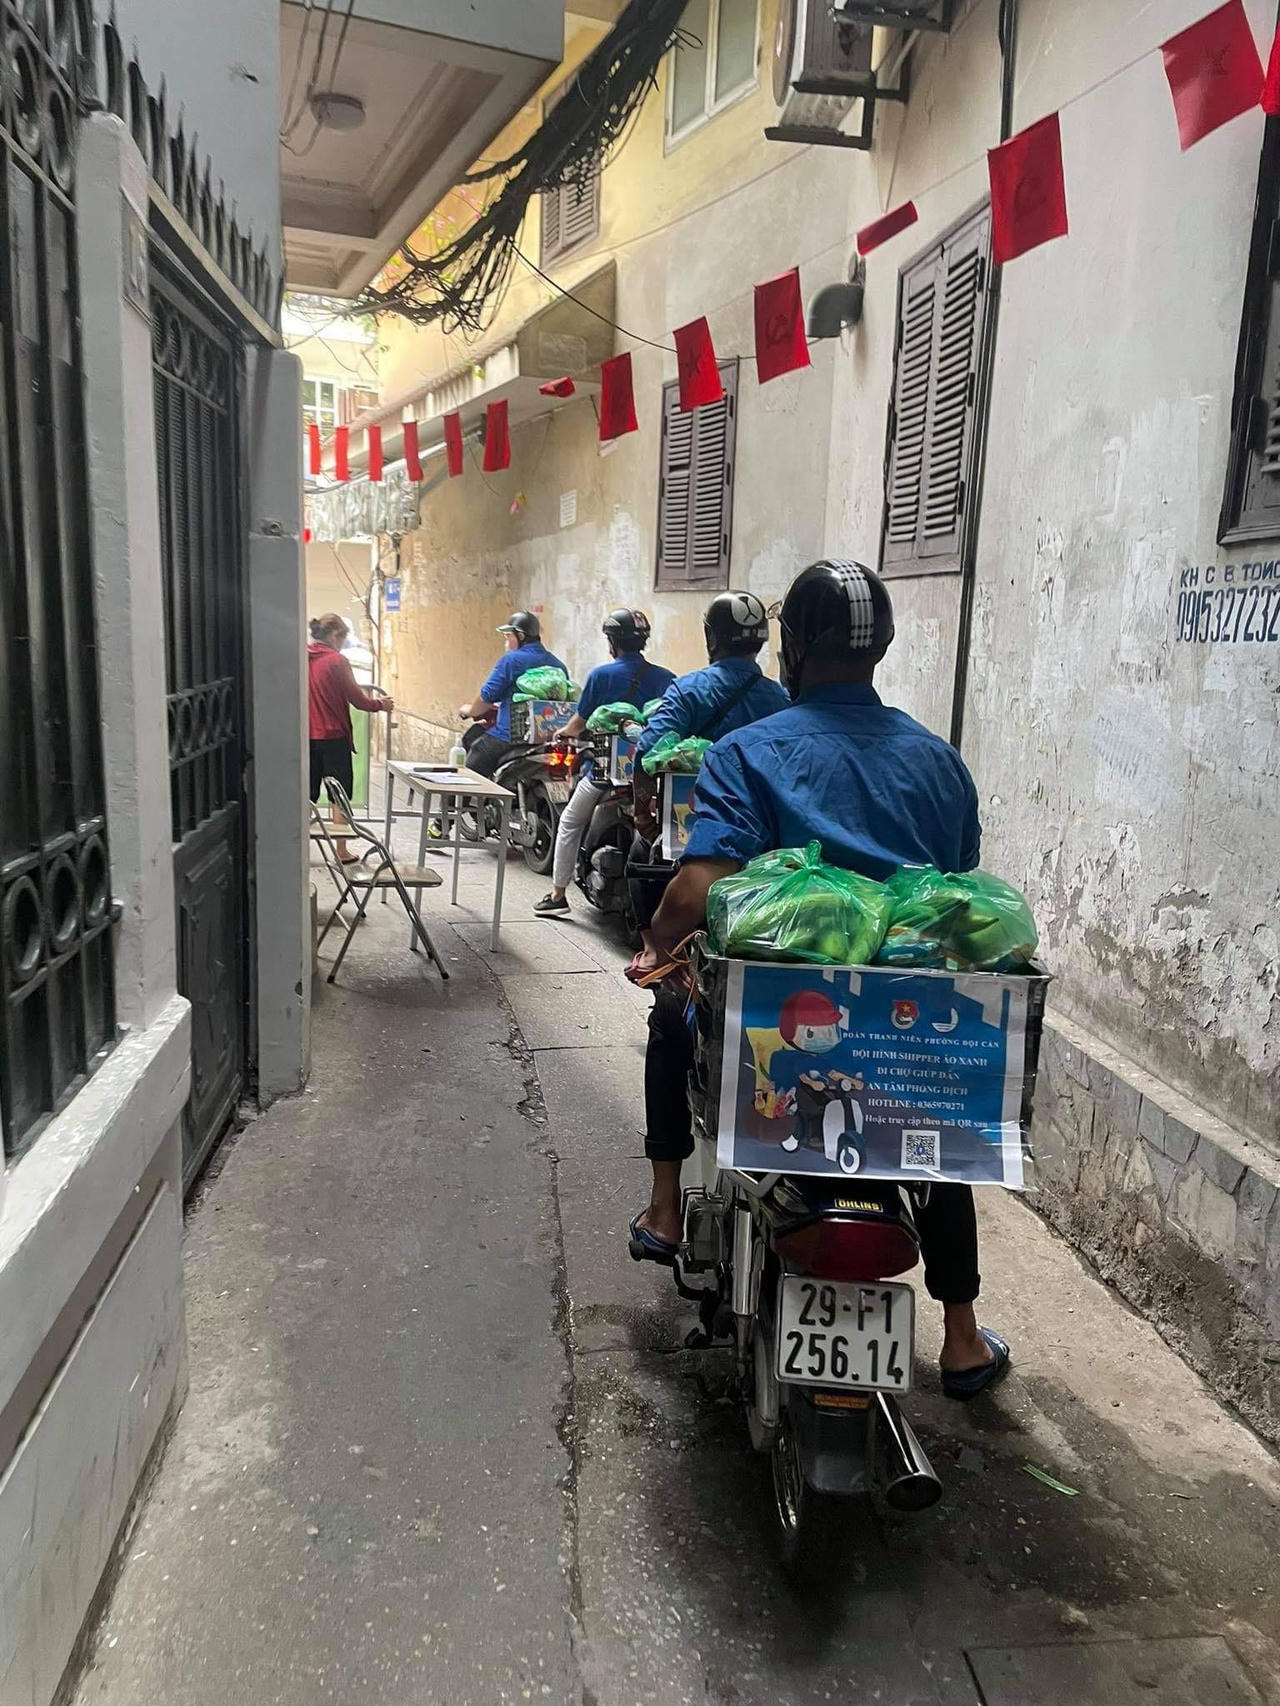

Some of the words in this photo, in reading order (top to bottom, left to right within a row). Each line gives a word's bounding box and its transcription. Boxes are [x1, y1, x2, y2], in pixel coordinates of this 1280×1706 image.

[869, 1032, 898, 1041] THANH
[898, 1051, 941, 1064] SHIPPER
[959, 1055, 988, 1067] XANH
[957, 1118, 972, 1129] QR
[799, 1283, 893, 1334] 29-F1
[785, 1331, 904, 1384] 256.14
